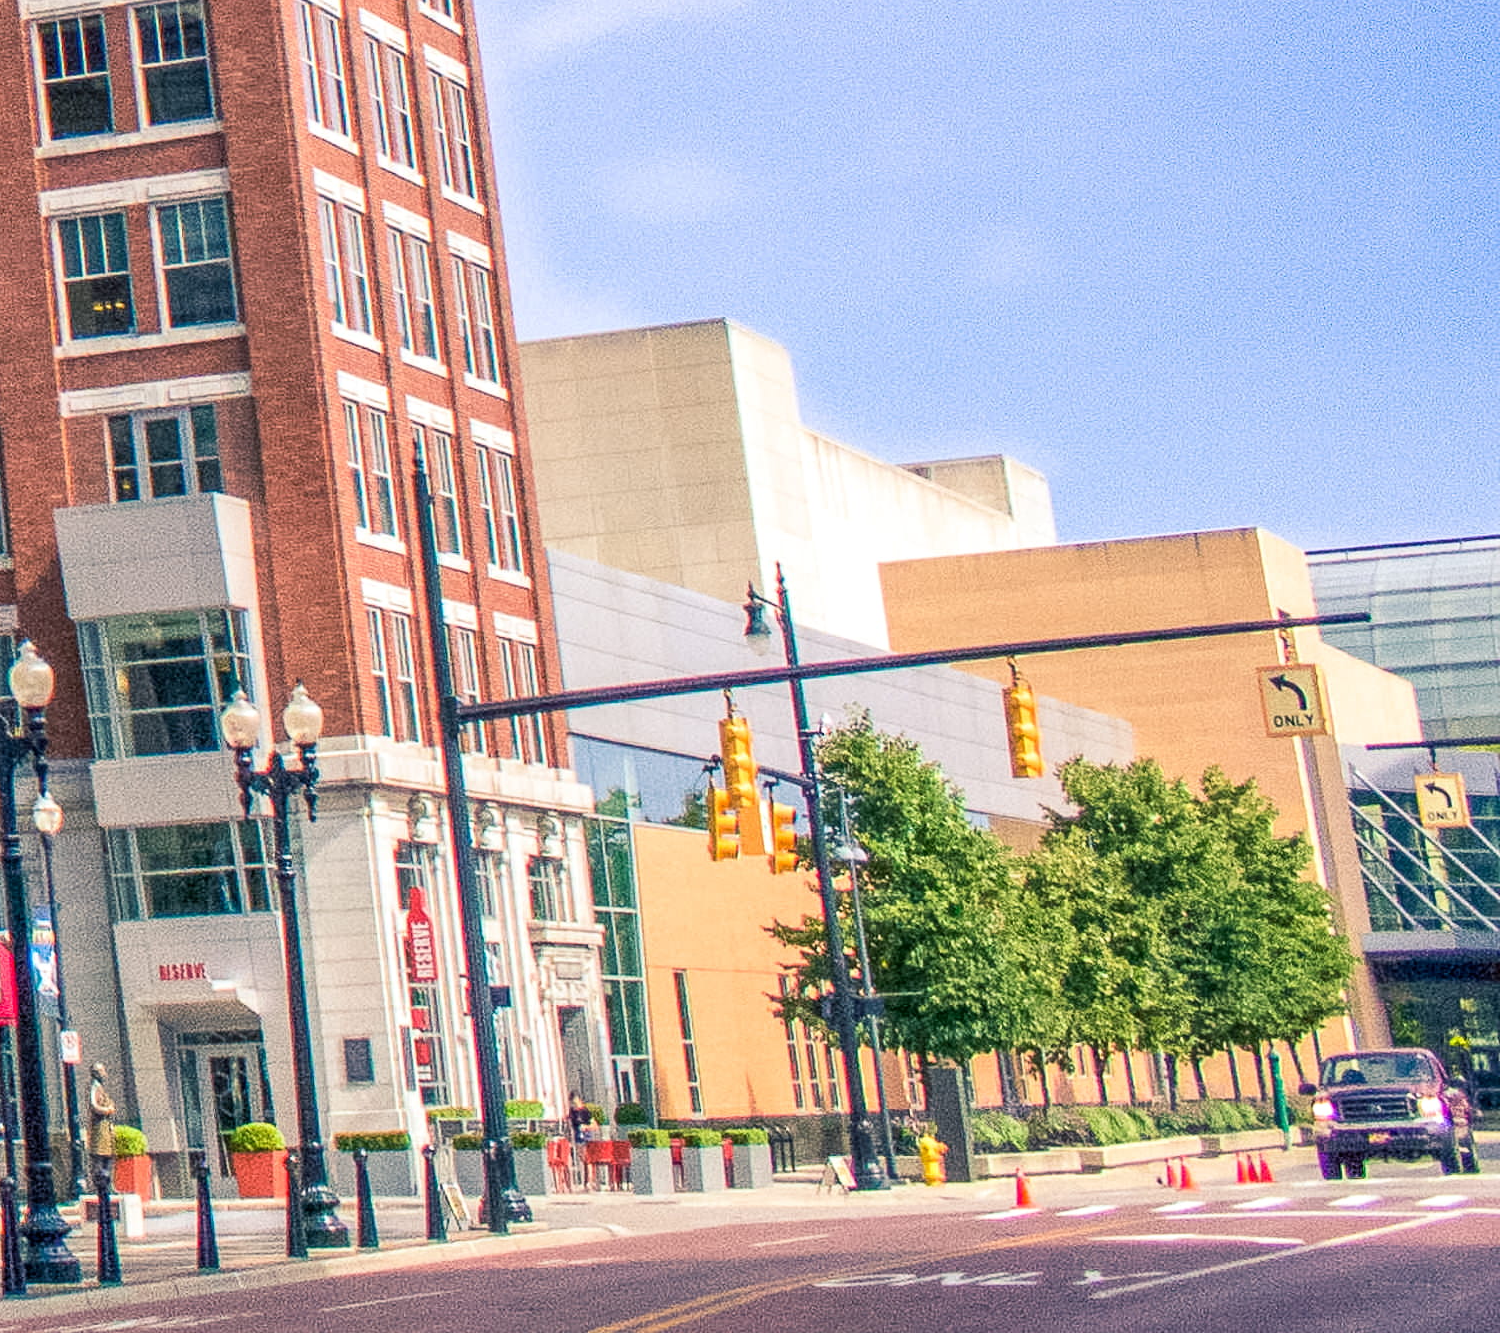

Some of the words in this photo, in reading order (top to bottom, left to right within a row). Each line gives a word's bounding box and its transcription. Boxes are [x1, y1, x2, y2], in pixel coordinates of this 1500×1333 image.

[1273, 714, 1314, 728] ONLY
[1427, 811, 1457, 822] ONLY
[410, 920, 435, 979] RESERVE
